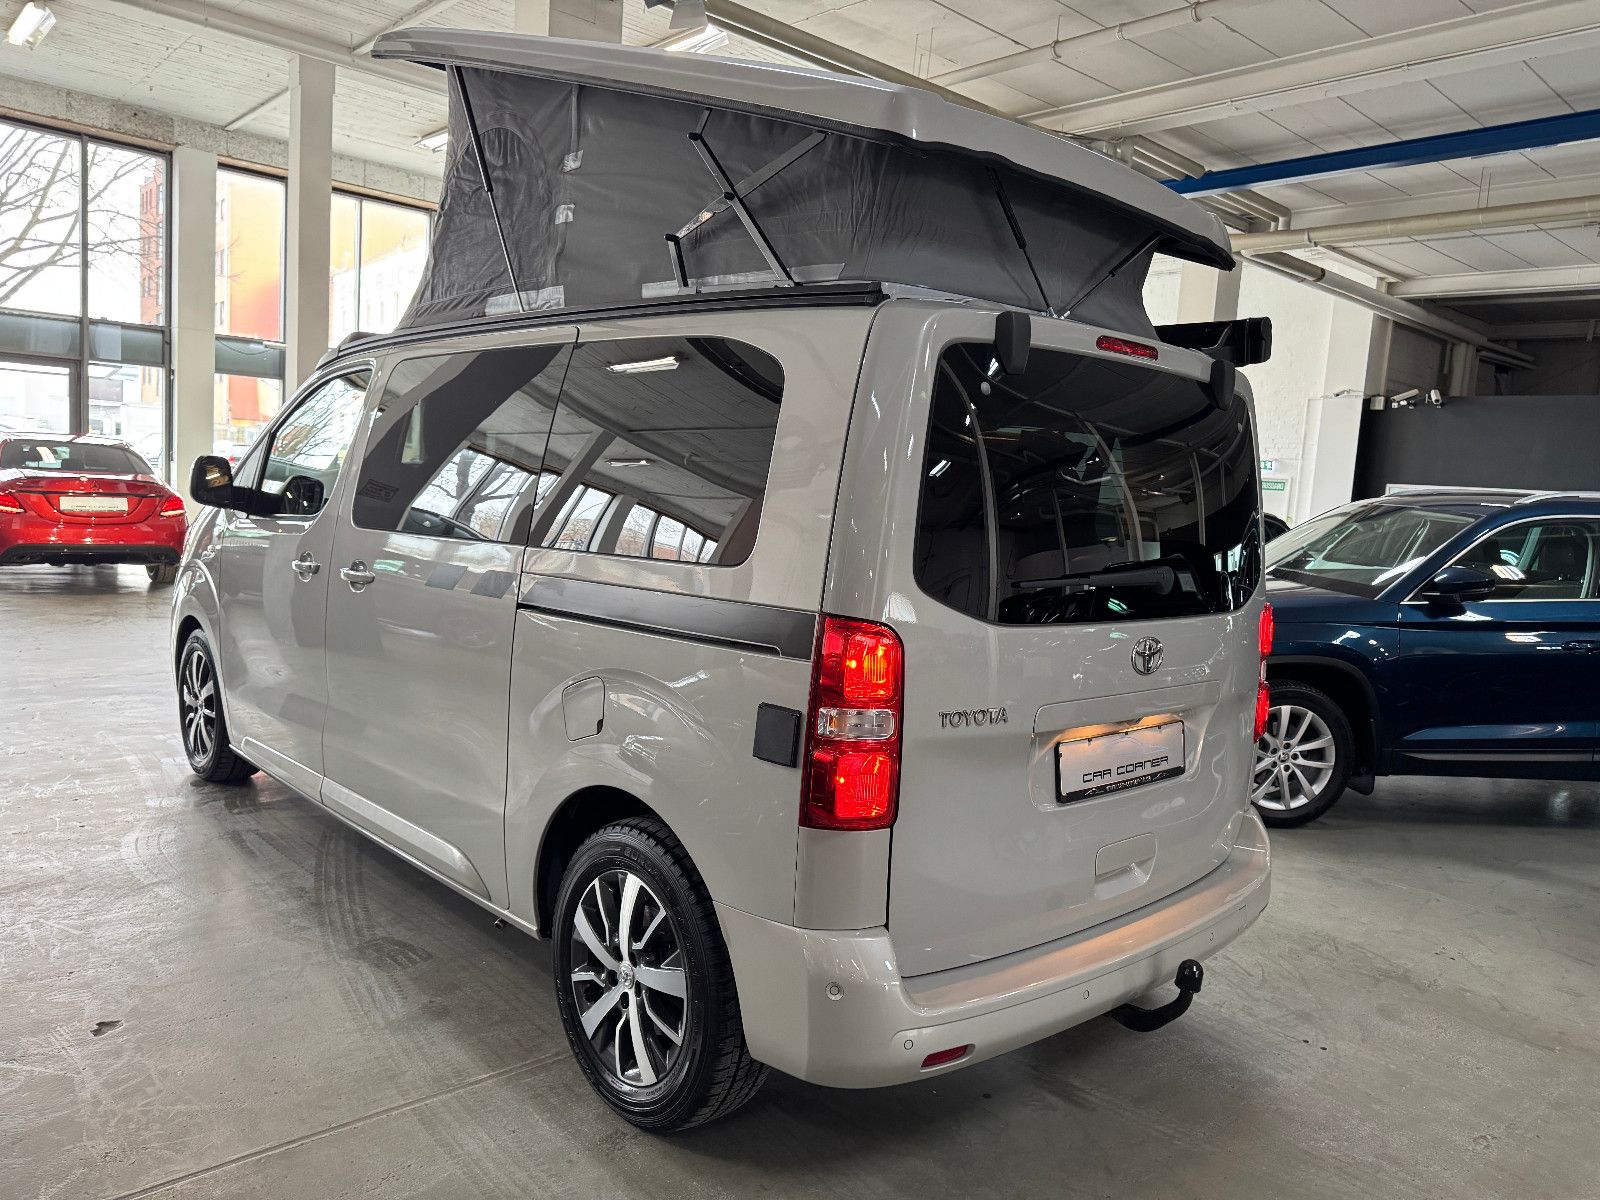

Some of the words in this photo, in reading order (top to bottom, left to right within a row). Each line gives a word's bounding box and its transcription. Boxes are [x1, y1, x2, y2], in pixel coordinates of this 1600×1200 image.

[939, 707, 1008, 728] TOYOTA
[1082, 768, 1112, 783] CAR
[1116, 755, 1169, 776] CORNER
